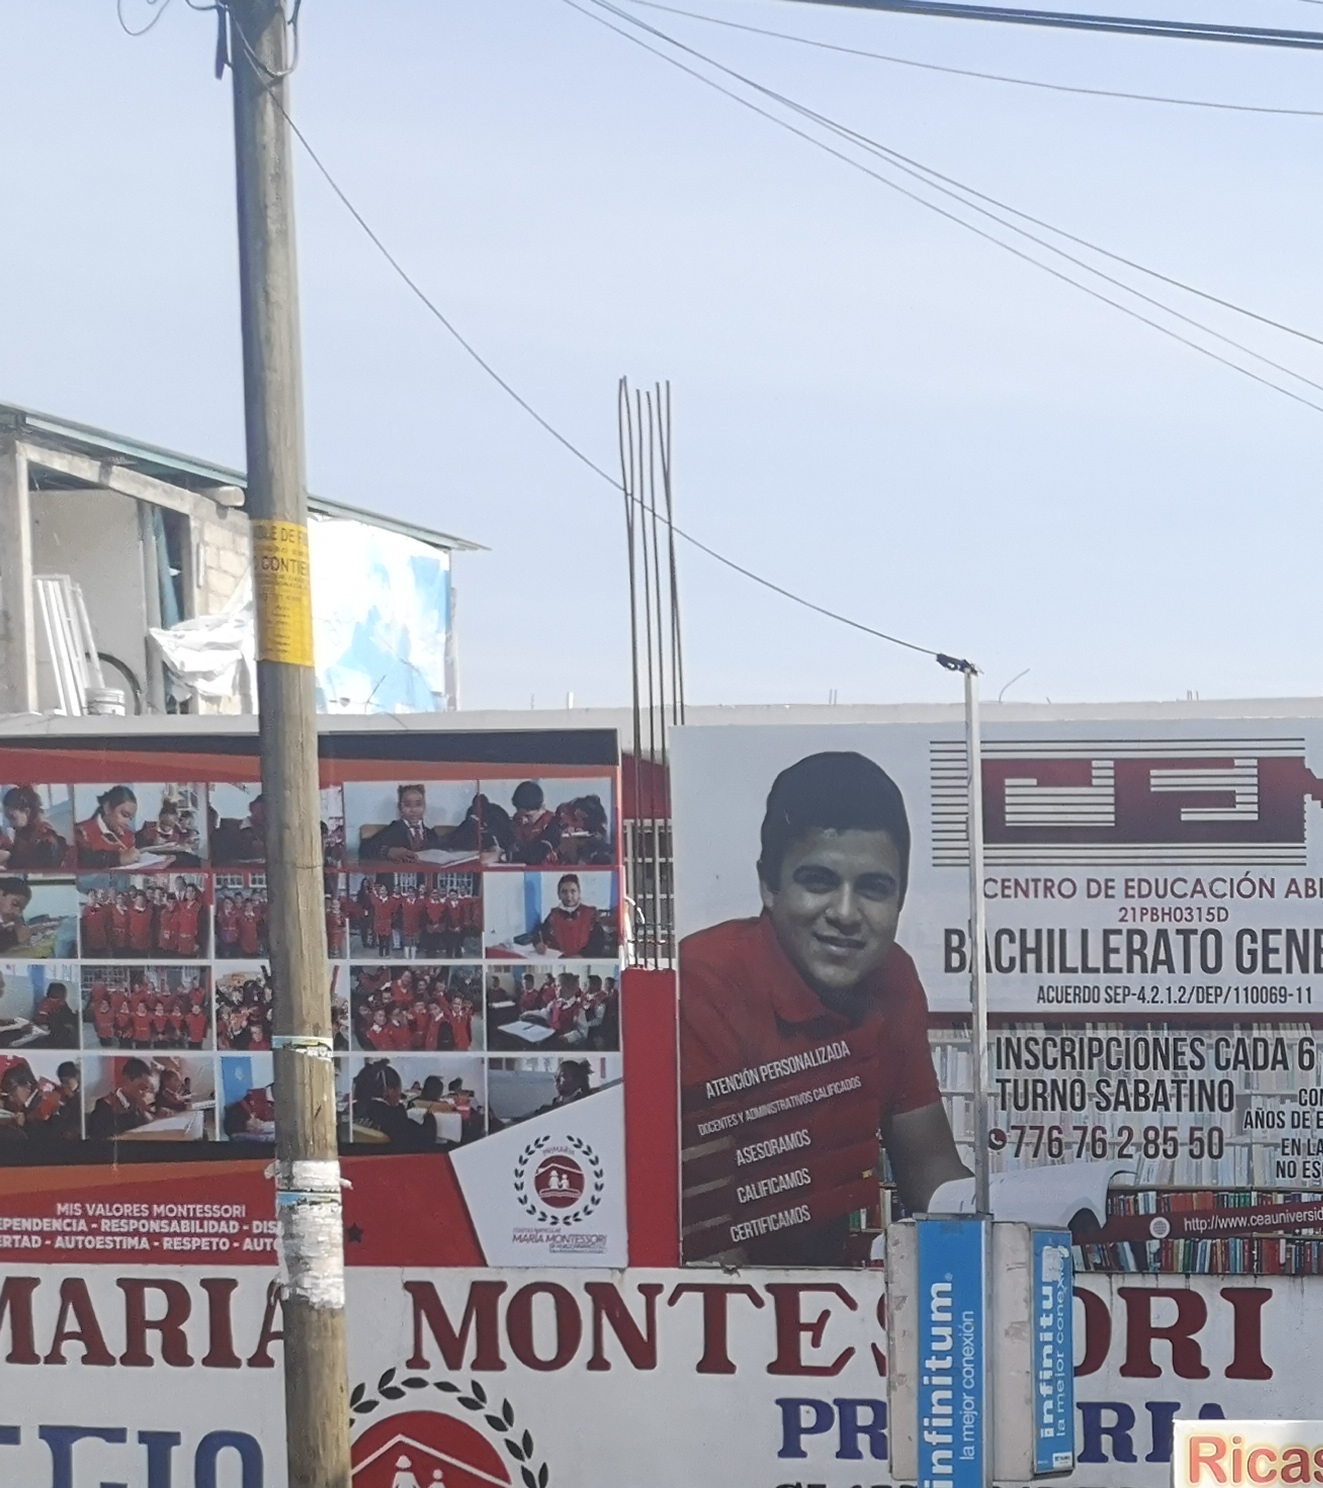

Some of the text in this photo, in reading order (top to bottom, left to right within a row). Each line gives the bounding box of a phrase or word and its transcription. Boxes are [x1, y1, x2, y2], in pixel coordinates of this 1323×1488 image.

[261, 555, 308, 577] CONTIE
[983, 876, 1078, 901] CENTRO
[1086, 877, 1116, 900] DE
[1123, 870, 1276, 900] EDUCACIÓN
[1118, 905, 1230, 924] 21PBH0315D
[1037, 985, 1101, 1005] ACUERDO
[996, 1036, 1206, 1071] INSCRIPCIONES
[1214, 1036, 1289, 1071] CADA
[1298, 1036, 1315, 1071] 6
[705, 1040, 851, 1100] ATENCIÓN PERSONALIZADA
[995, 1077, 1236, 1112] TURNO SABATINO
[697, 1113, 738, 1136] DOCENTES
[1243, 1107, 1286, 1130] AÑOS
[1291, 1110, 1311, 1130] DE
[735, 1128, 811, 1167] ASESORAMOS
[1011, 1124, 1225, 1160] 776 76 2 85 50
[1281, 1138, 1302, 1157] EN
[1276, 1160, 1297, 1180] NO
[736, 1168, 811, 1204] CALIFICAMOS
[57, 1203, 246, 1218] MIS VALORES MONTESSORI
[101, 1220, 240, 1234] RESPONSABILIDAD
[251, 1220, 280, 1234] DIS
[729, 1204, 811, 1243] CERTIFICAMOS
[54, 1236, 150, 1250] AUTOESTIMA
[162, 1237, 230, 1251] RESPETO
[1039, 1246, 1056, 1439] infinitu
[958, 1310, 979, 1461] la mejor conexión
[1056, 1418, 1066, 1437] la
